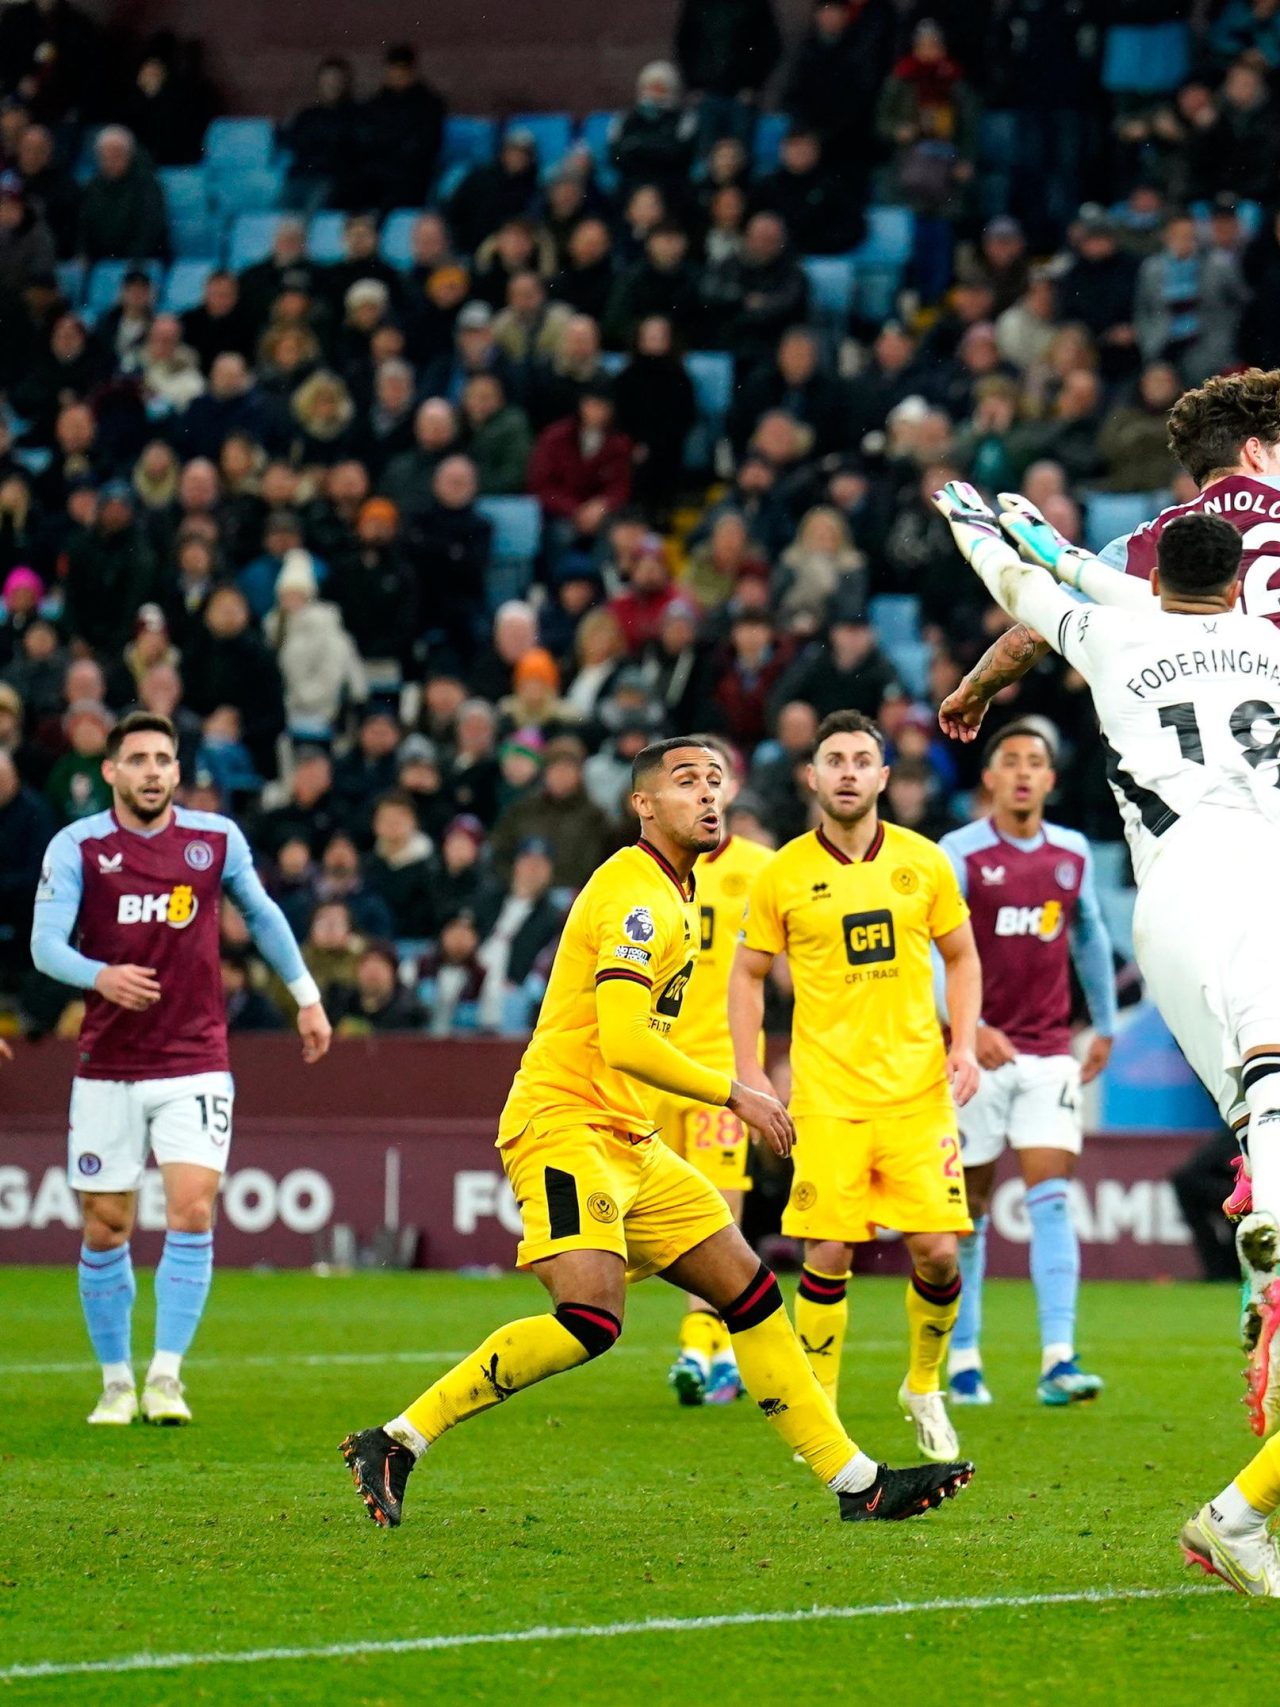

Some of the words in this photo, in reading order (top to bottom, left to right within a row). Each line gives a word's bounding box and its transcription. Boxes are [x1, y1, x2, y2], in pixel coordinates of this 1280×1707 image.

[117, 885, 199, 929] BK8
[850, 922, 891, 952] CFI
[195, 1094, 229, 1133] 15
[696, 1110, 744, 1148] 28
[940, 1137, 960, 1178] 2
